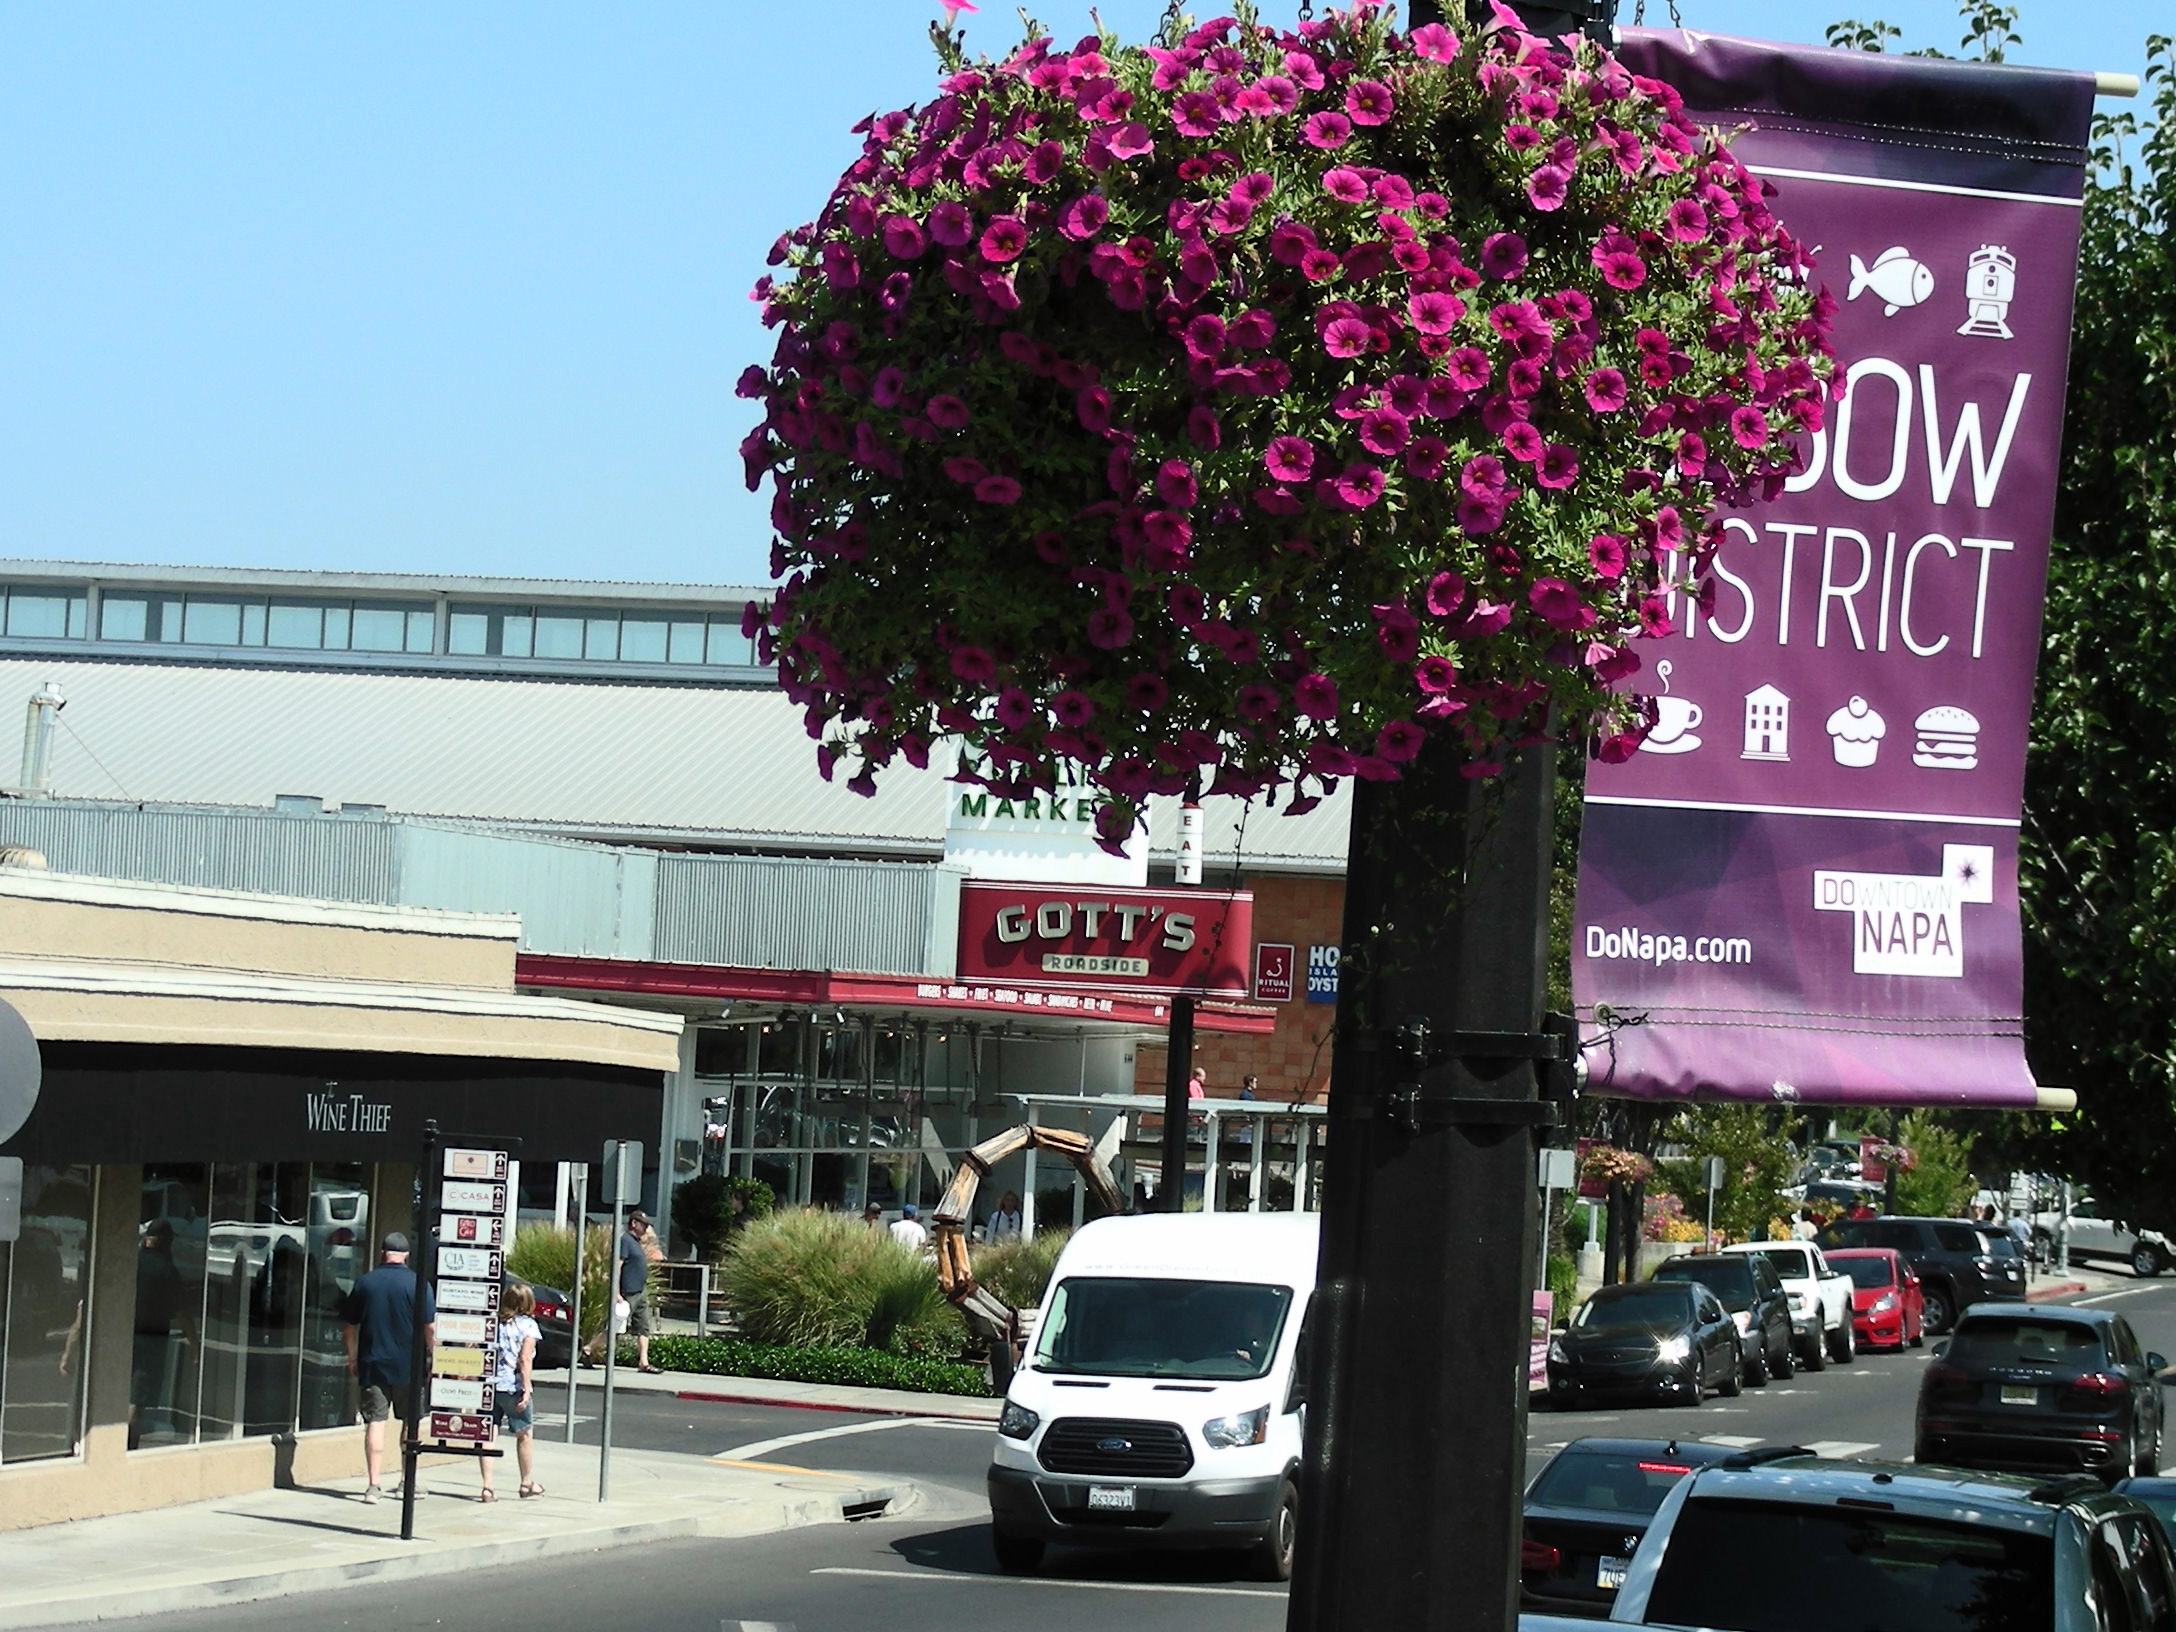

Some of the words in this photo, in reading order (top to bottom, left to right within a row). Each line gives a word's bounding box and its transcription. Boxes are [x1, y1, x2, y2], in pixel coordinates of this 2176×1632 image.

[961, 793, 1091, 822] MARKE
[1823, 877, 1953, 911] DOWNTOWN
[996, 901, 1197, 952] GOTT'S
[1861, 910, 1955, 957] NAPA
[1308, 945, 1341, 968] HO
[1585, 924, 1753, 968] DoNapa.com
[1050, 955, 1142, 974] ROADSIDE
[1308, 967, 1338, 976] ISLA
[1258, 978, 1290, 988] RITUAL
[1307, 977, 1339, 993] OYST
[460, 1191, 490, 1200] CASA
